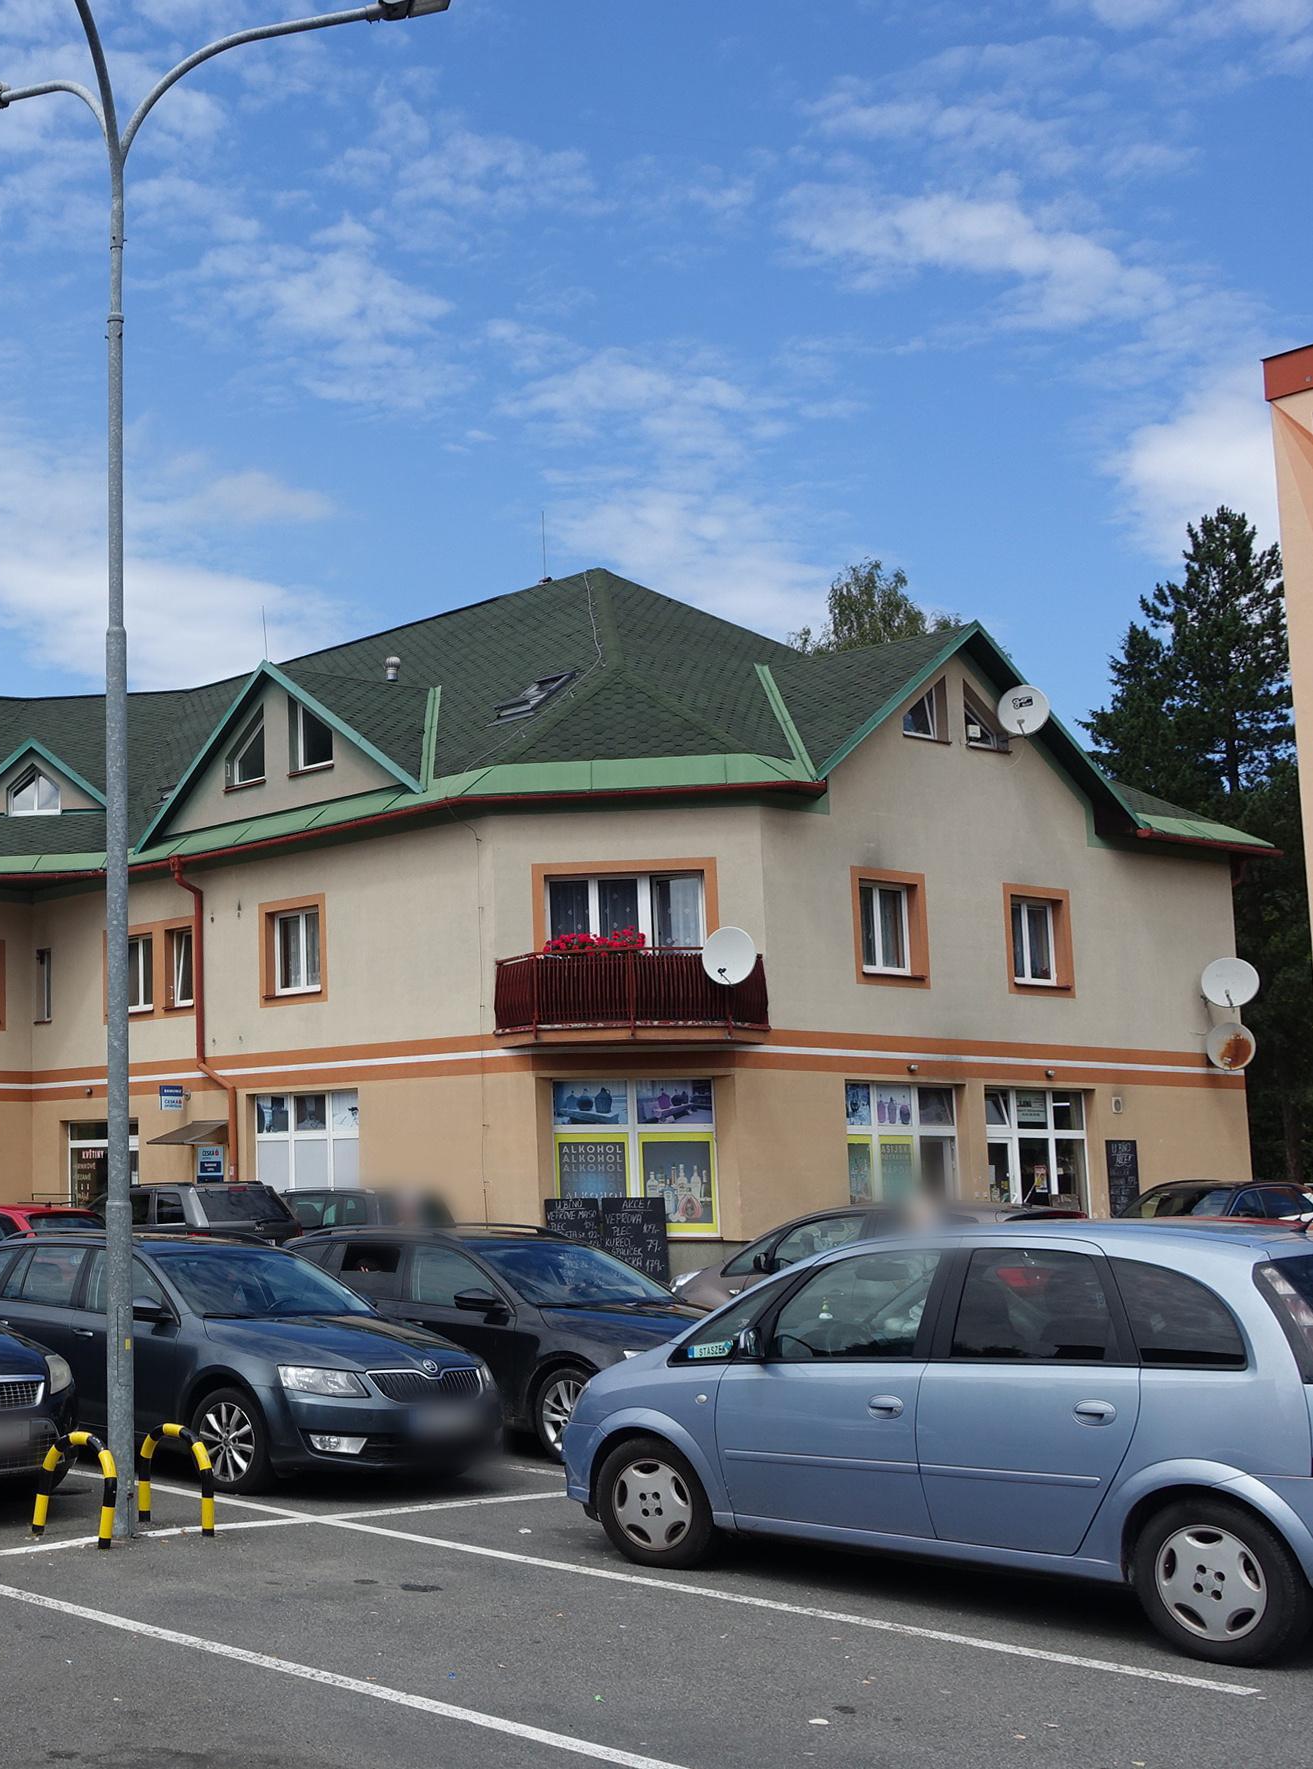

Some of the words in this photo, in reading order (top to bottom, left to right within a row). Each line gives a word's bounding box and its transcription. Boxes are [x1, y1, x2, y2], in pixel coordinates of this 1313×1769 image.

[562, 1145, 622, 1153] ALKOHOL
[562, 1154, 623, 1163] ALKOHOL
[563, 1163, 623, 1172] ALKOHOL
[622, 1200, 644, 1209] AKCE
